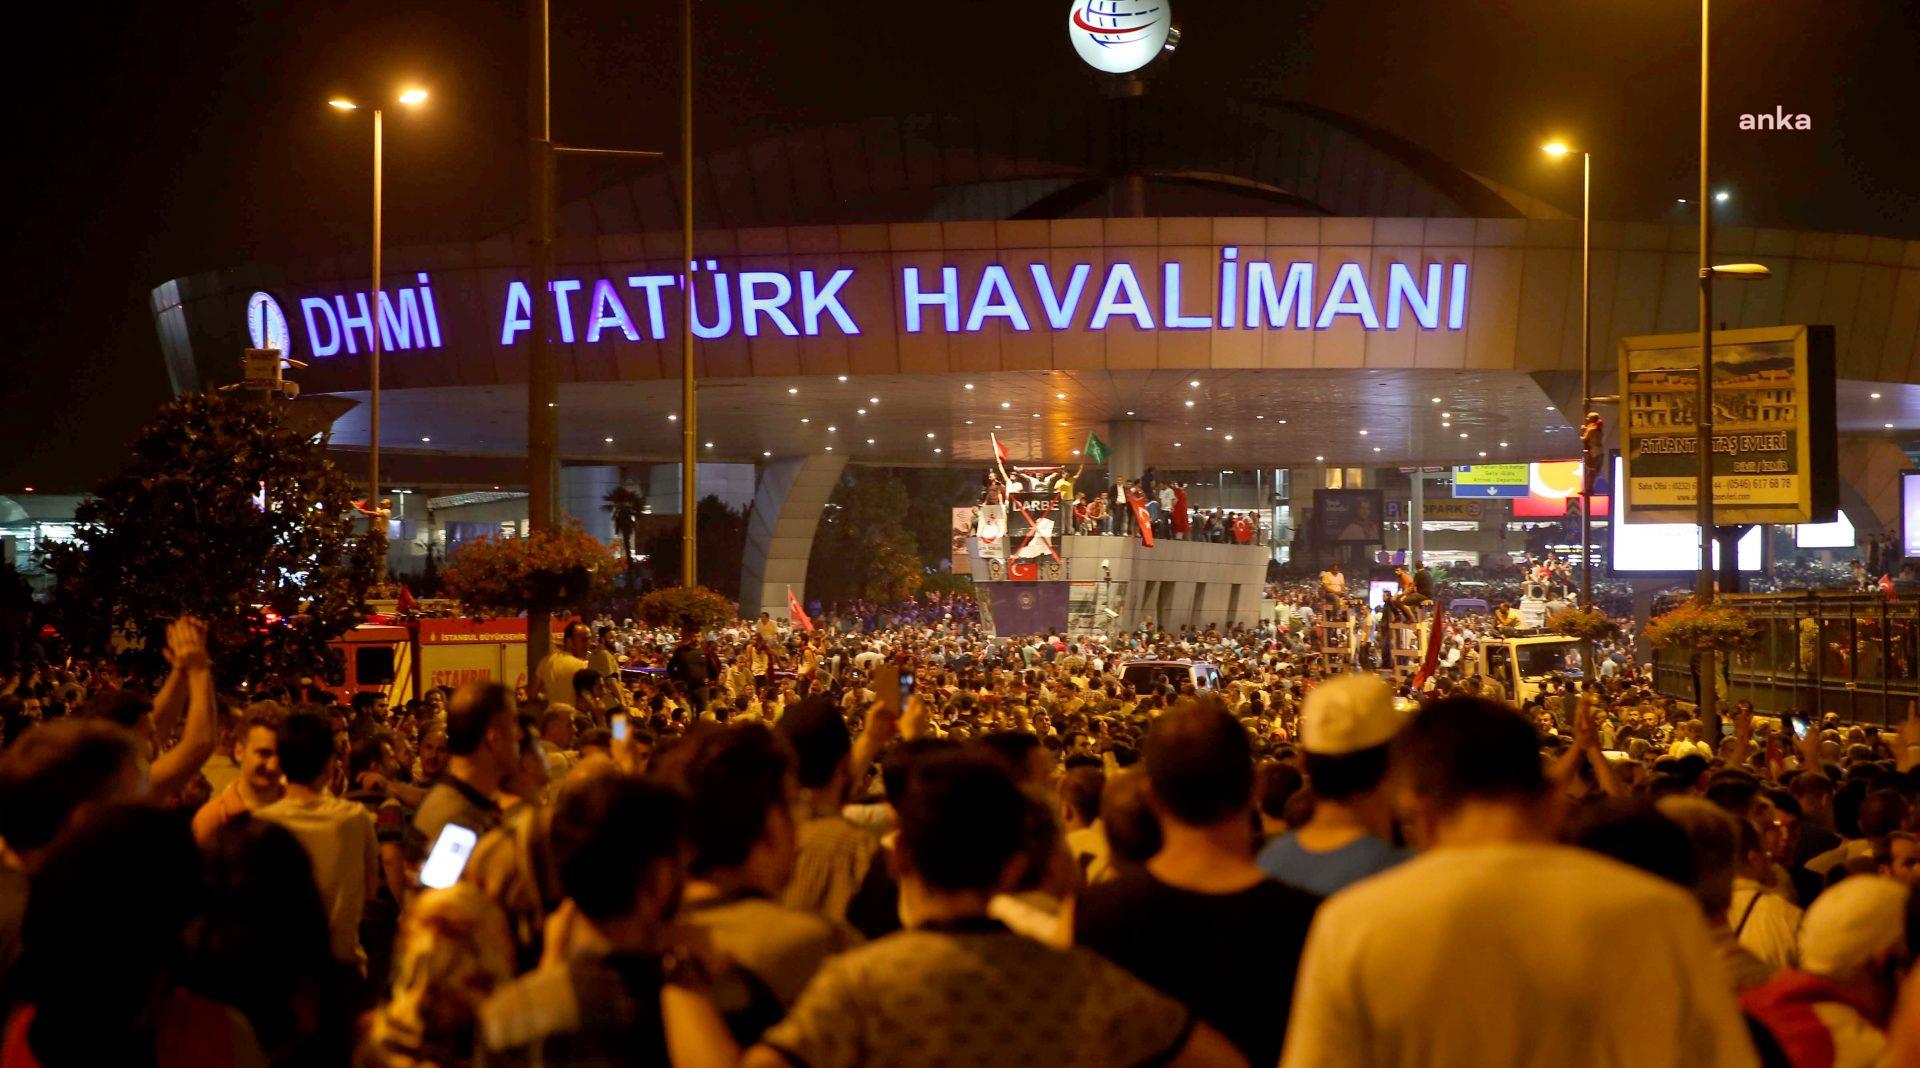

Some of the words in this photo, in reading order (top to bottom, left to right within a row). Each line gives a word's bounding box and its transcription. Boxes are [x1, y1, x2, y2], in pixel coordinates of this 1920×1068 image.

[300, 272, 442, 358] DHMİ
[501, 259, 862, 345] ATATÜRK
[902, 246, 1469, 332] HAVALİMANI
[1740, 431, 1788, 451] EVLERİ
